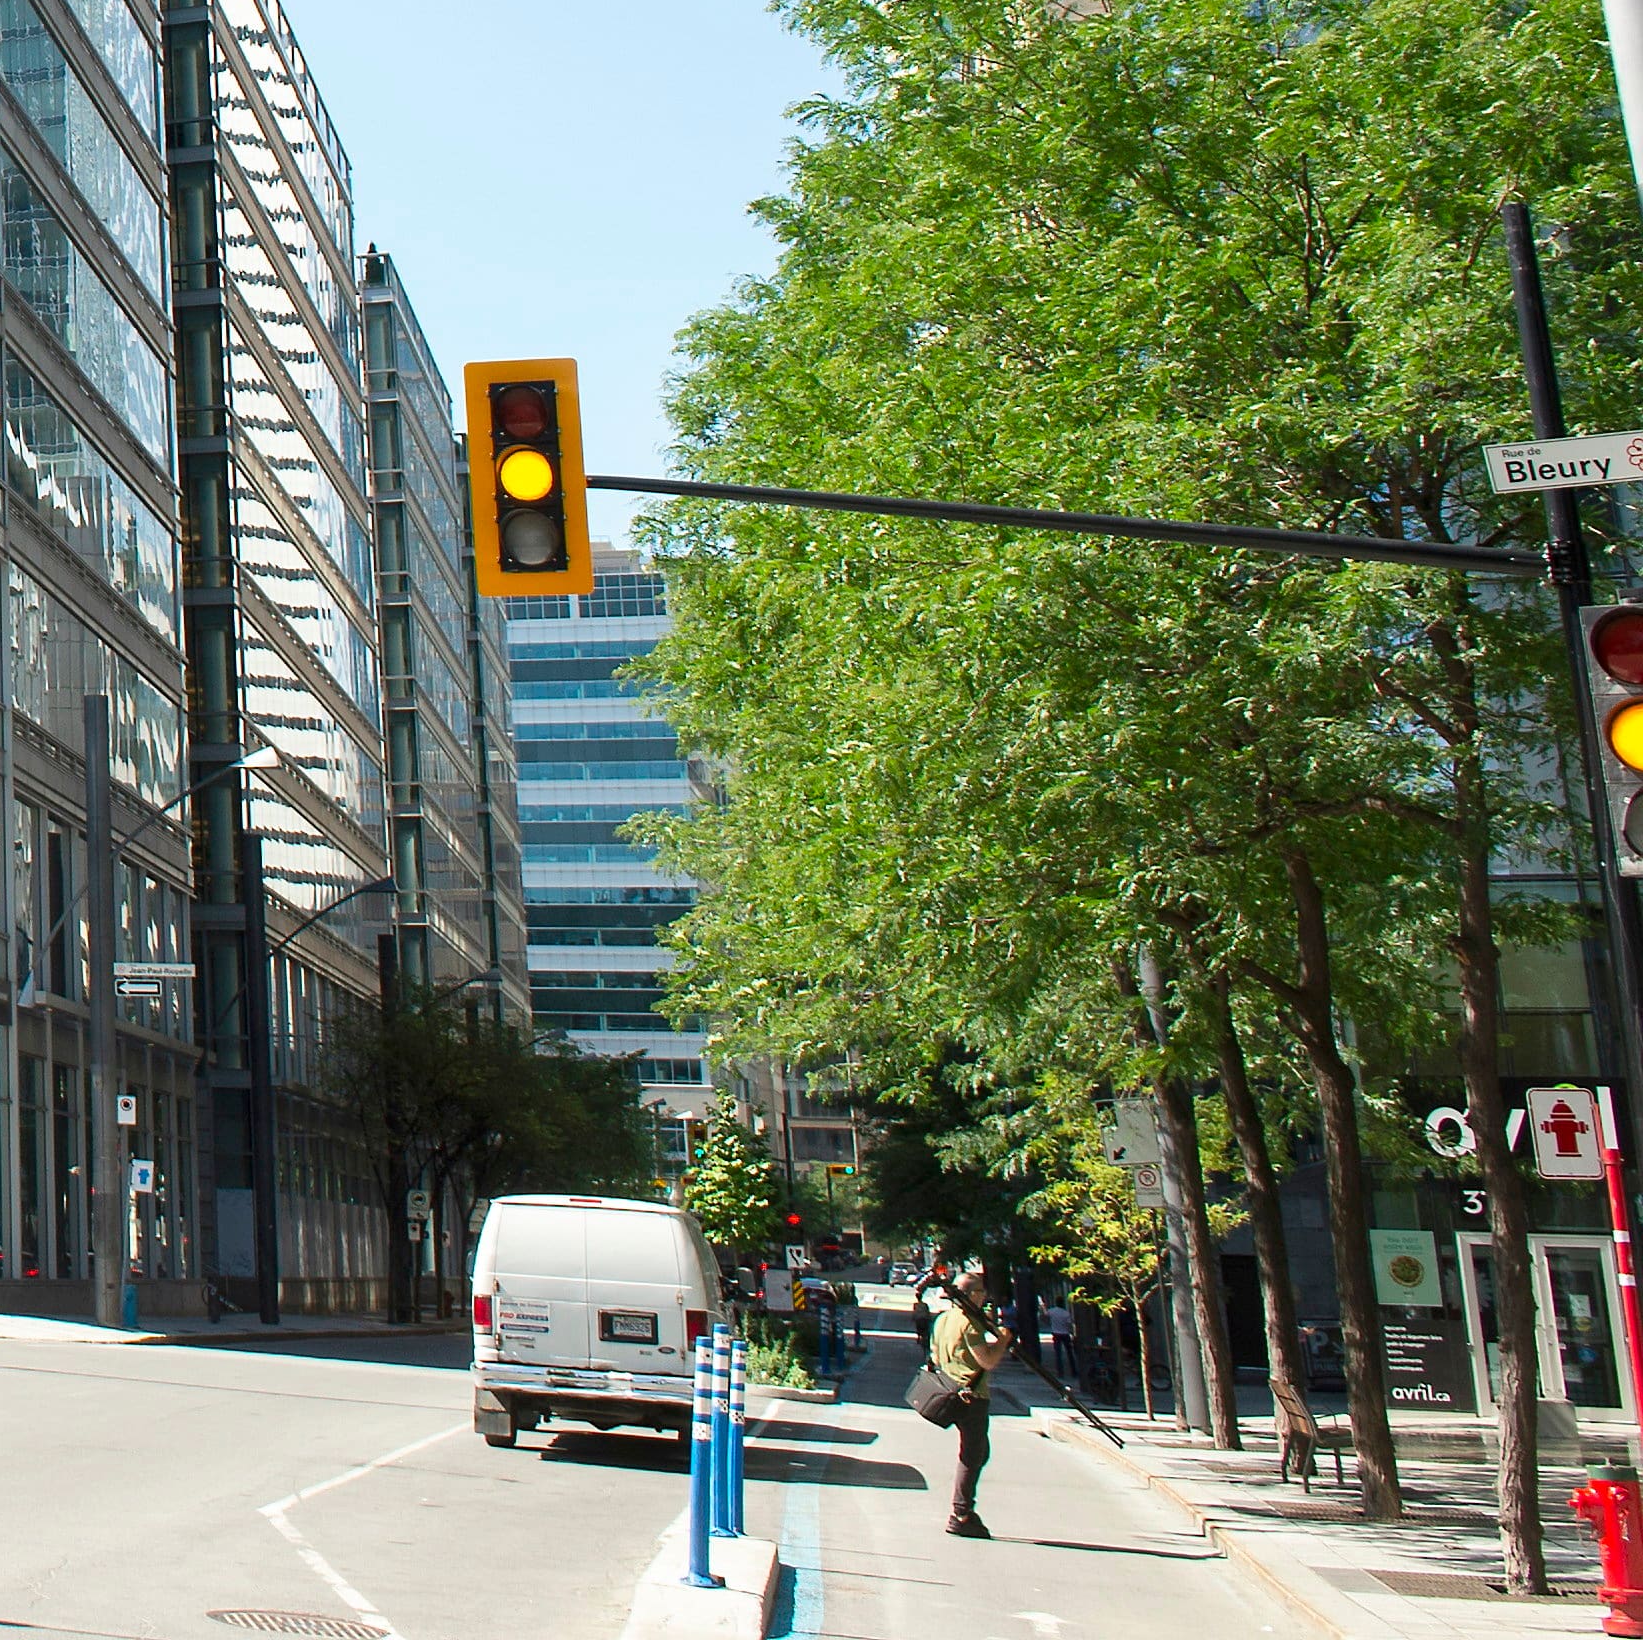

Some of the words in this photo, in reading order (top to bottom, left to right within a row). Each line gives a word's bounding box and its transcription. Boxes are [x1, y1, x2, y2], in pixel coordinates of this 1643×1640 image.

[1501, 449, 1524, 458] Rue
[1527, 446, 1541, 456] de
[1505, 458, 1611, 484] Bleury
[1391, 1382, 1452, 1402] avril.ca
